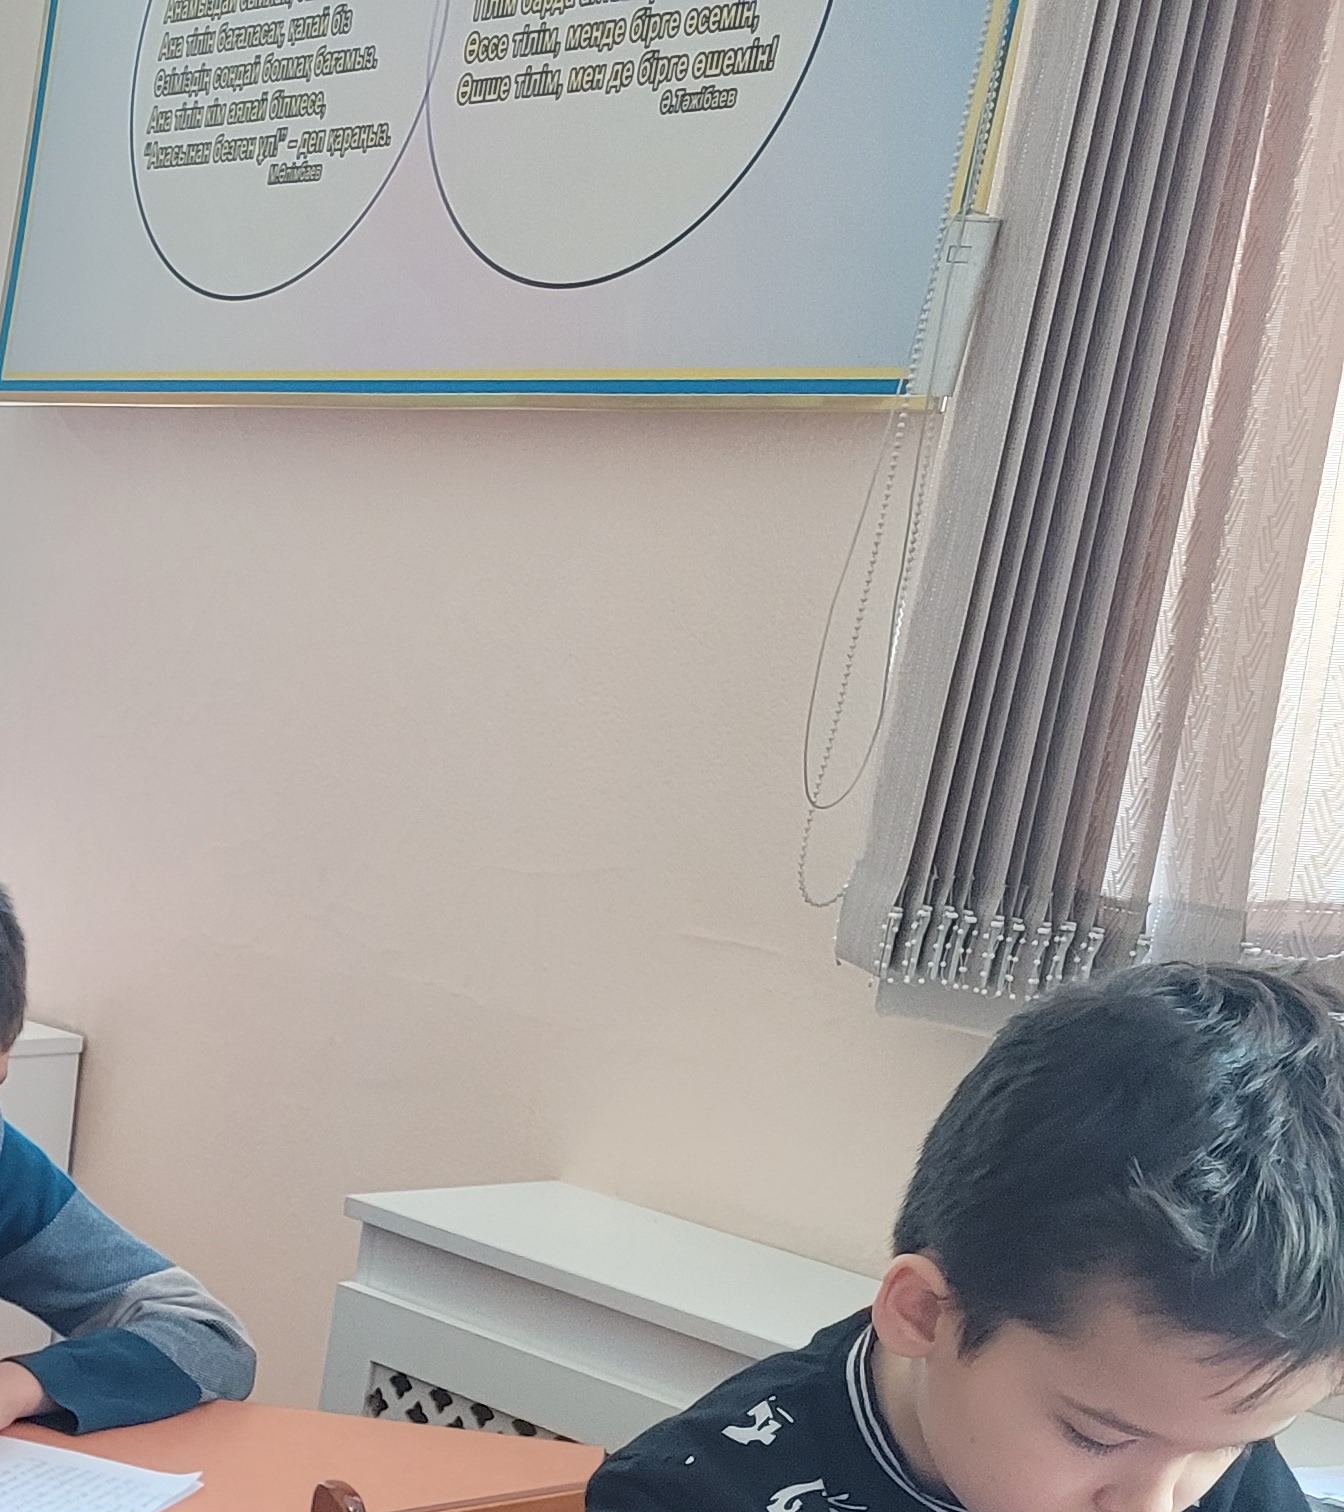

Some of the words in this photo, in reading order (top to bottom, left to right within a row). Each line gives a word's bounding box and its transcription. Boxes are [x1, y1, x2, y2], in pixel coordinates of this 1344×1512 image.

[157, 32, 184, 61] Ана
[185, 24, 216, 57] тілін
[287, 6, 330, 46] қалай
[330, 3, 354, 36] біз
[463, 31, 510, 64] Өссе
[511, 22, 562, 59] тілім,
[563, 17, 628, 52] менде
[629, 6, 683, 49] бірге
[683, 0, 762, 37] өсемін,
[212, 54, 263, 92] сондай
[261, 52, 314, 83] болмақ
[313, 45, 379, 78] бағамыз.
[455, 73, 512, 106] Өшше
[512, 63, 564, 100] тілім,
[565, 61, 607, 94] мен
[604, 59, 636, 96] де
[635, 49, 691, 91] бірге
[690, 34, 781, 81] өшемін!
[146, 105, 173, 135] Ана
[174, 100, 205, 131] тілін
[203, 97, 226, 128] кім
[225, 91, 269, 125] аялай
[267, 89, 327, 121] білмесе,
[212, 133, 257, 164] безген
[295, 130, 327, 160] деп
[326, 122, 391, 159] қараңыз.
